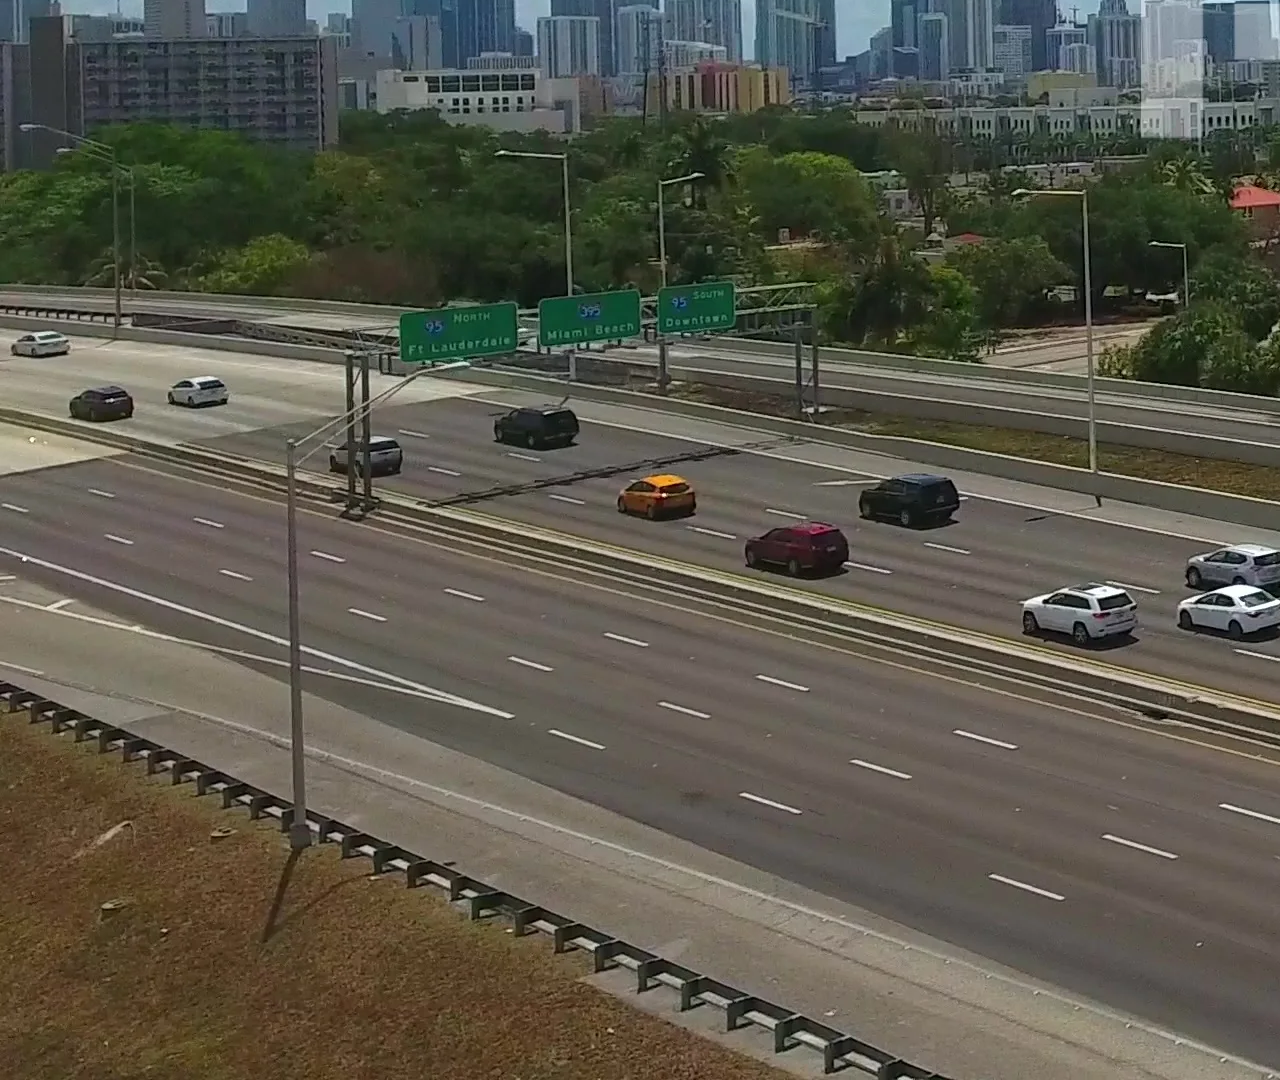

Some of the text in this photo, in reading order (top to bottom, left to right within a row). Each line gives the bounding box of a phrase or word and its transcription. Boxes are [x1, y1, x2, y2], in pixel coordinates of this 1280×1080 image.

[672, 297, 687, 308] 95
[425, 320, 443, 333] 95
[665, 314, 728, 327] Downtown
[547, 322, 634, 340] Miami Beach
[408, 337, 511, 356] Ft Lauderdale
